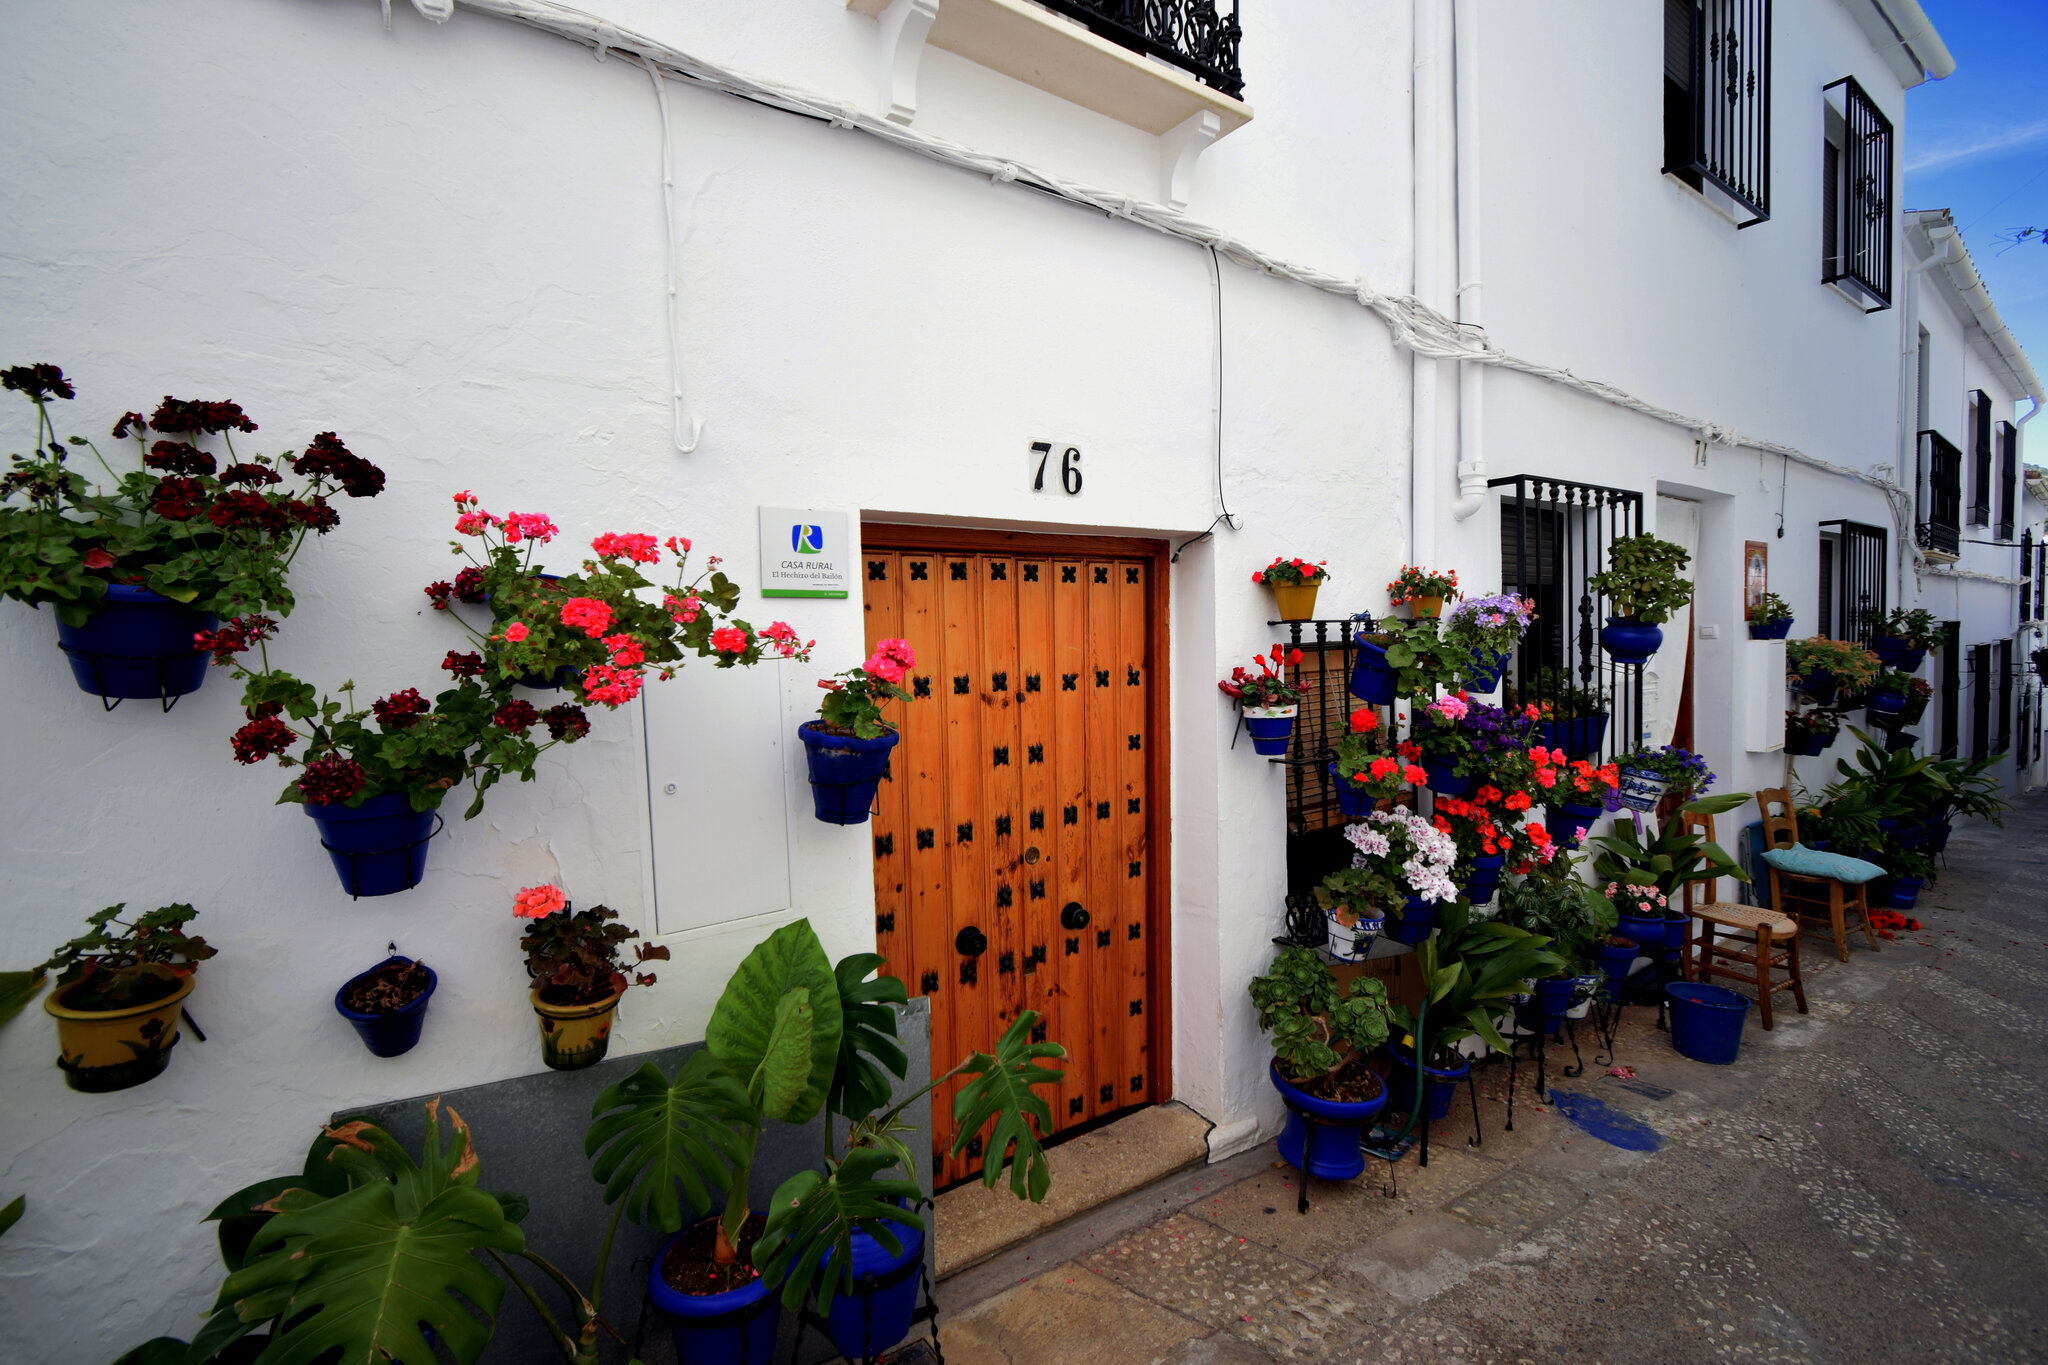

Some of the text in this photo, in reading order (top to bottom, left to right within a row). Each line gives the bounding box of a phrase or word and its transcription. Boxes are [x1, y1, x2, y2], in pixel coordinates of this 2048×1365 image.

[1694, 440, 1707, 466] 74
[1031, 441, 1083, 495] 76
[781, 560, 834, 570] CASA RURAL
[780, 571, 808, 579] Hechizo
[822, 572, 843, 580] Bailón
